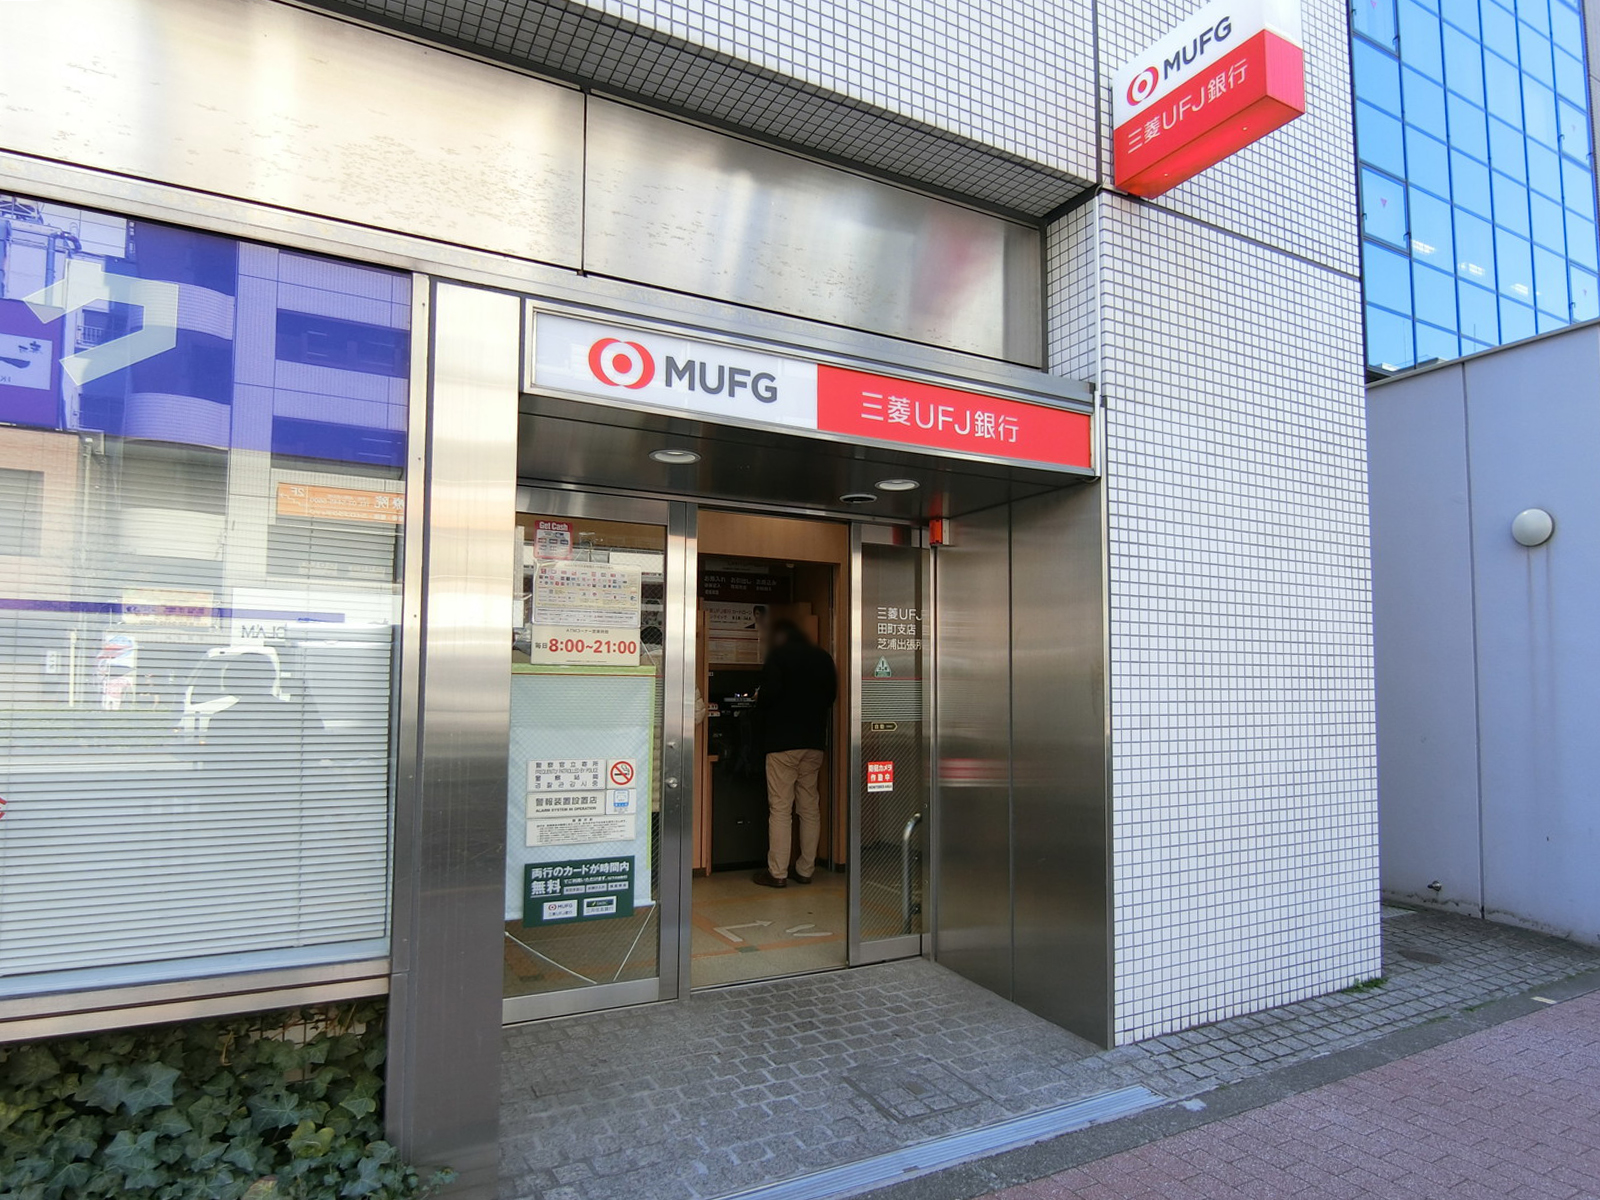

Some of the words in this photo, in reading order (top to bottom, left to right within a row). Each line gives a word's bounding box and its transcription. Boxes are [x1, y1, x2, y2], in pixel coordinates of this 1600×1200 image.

[1164, 16, 1232, 80] MUFG
[1128, 59, 1248, 154] 三菱UFJ銀行
[665, 356, 778, 403] MUFG
[861, 391, 1020, 443] 三菱UFJ銀行
[539, 521, 551, 530] Get
[552, 522, 568, 531] Cash
[877, 622, 916, 635] 田町支店
[535, 796, 597, 806] 警報装置設置店
[531, 861, 630, 879] 両行のカードが時間内
[531, 879, 561, 895] 無料
